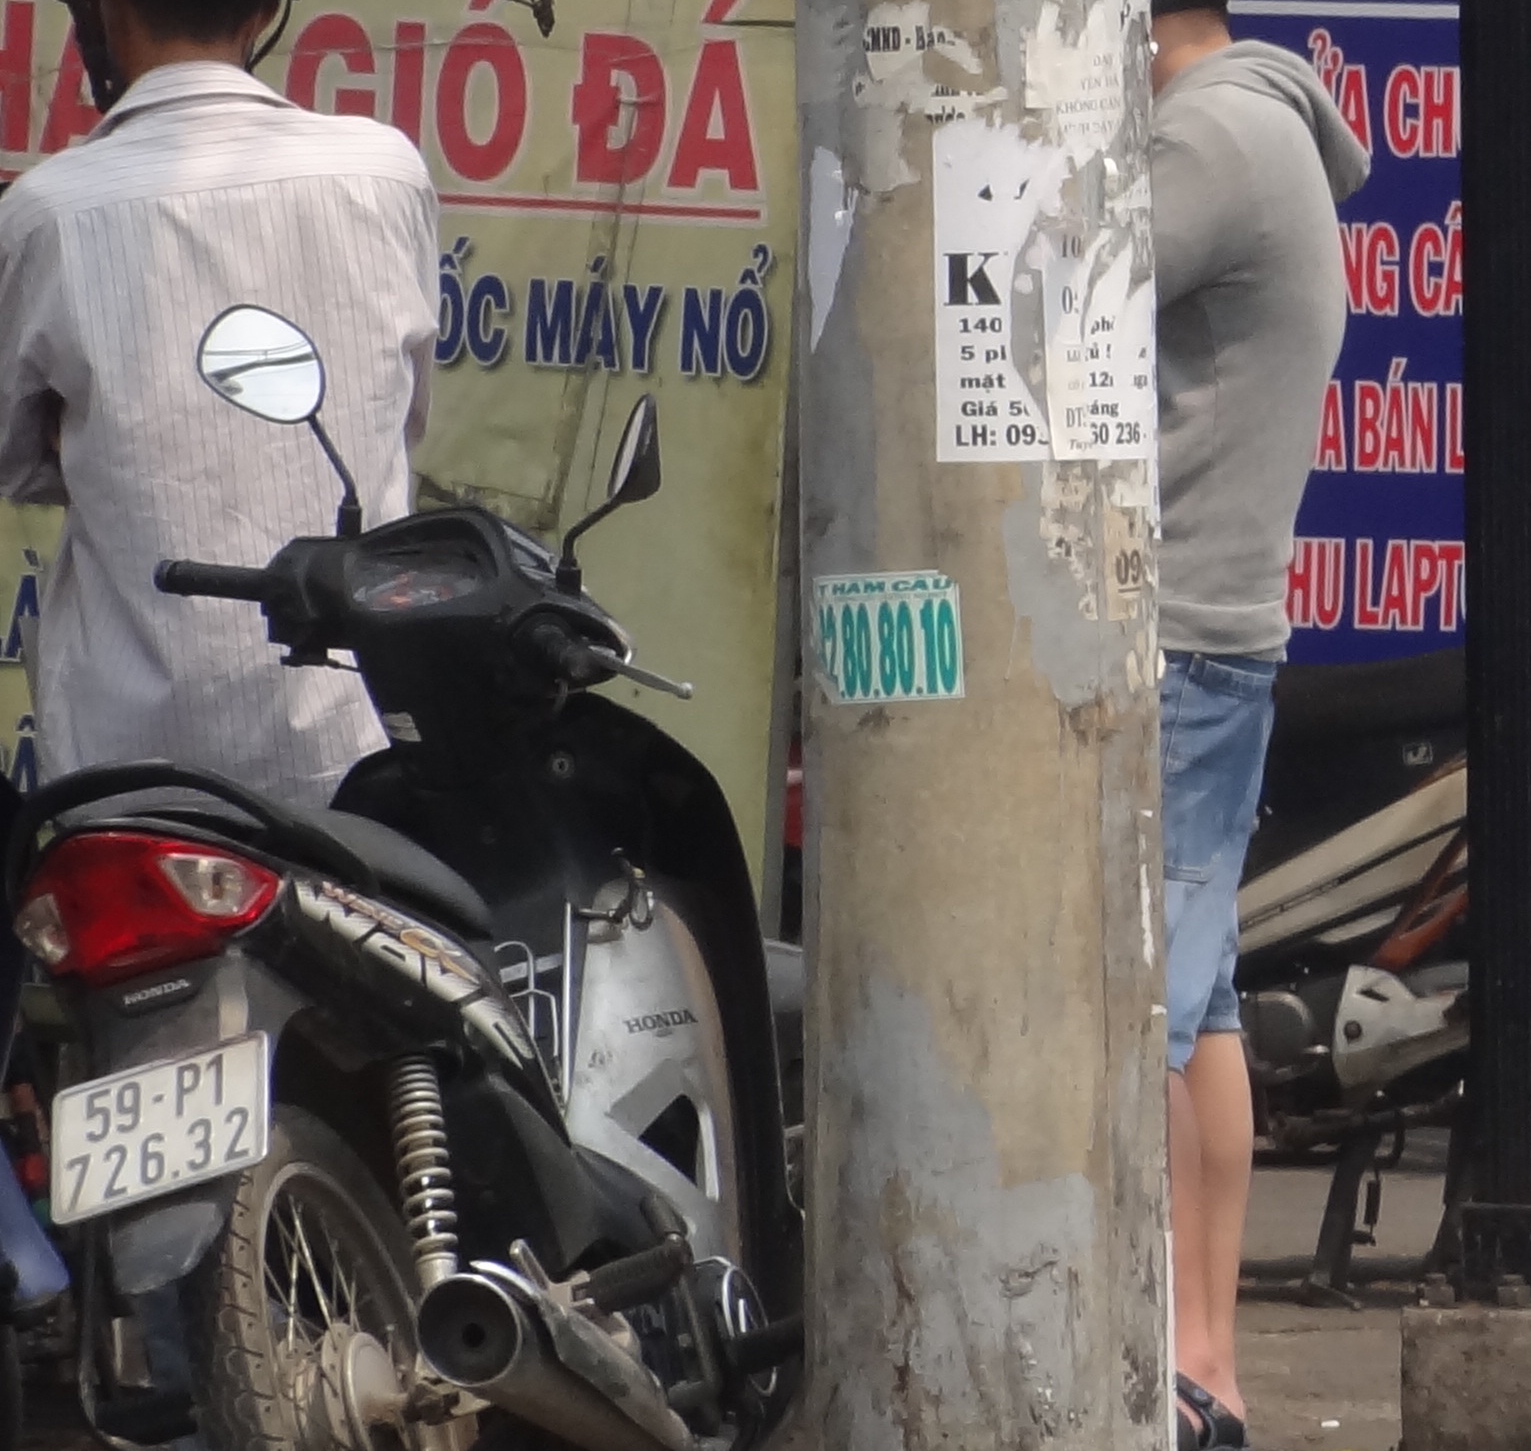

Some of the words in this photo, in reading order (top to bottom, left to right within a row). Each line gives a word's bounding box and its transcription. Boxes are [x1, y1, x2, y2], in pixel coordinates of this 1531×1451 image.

[1383, 64, 1461, 159] CH
[524, 252, 661, 376] MÁY
[679, 242, 774, 382] NỔ
[1353, 356, 1438, 474] BÁN
[1352, 539, 1466, 633] LAPT
[624, 1007, 698, 1035] HONDA
